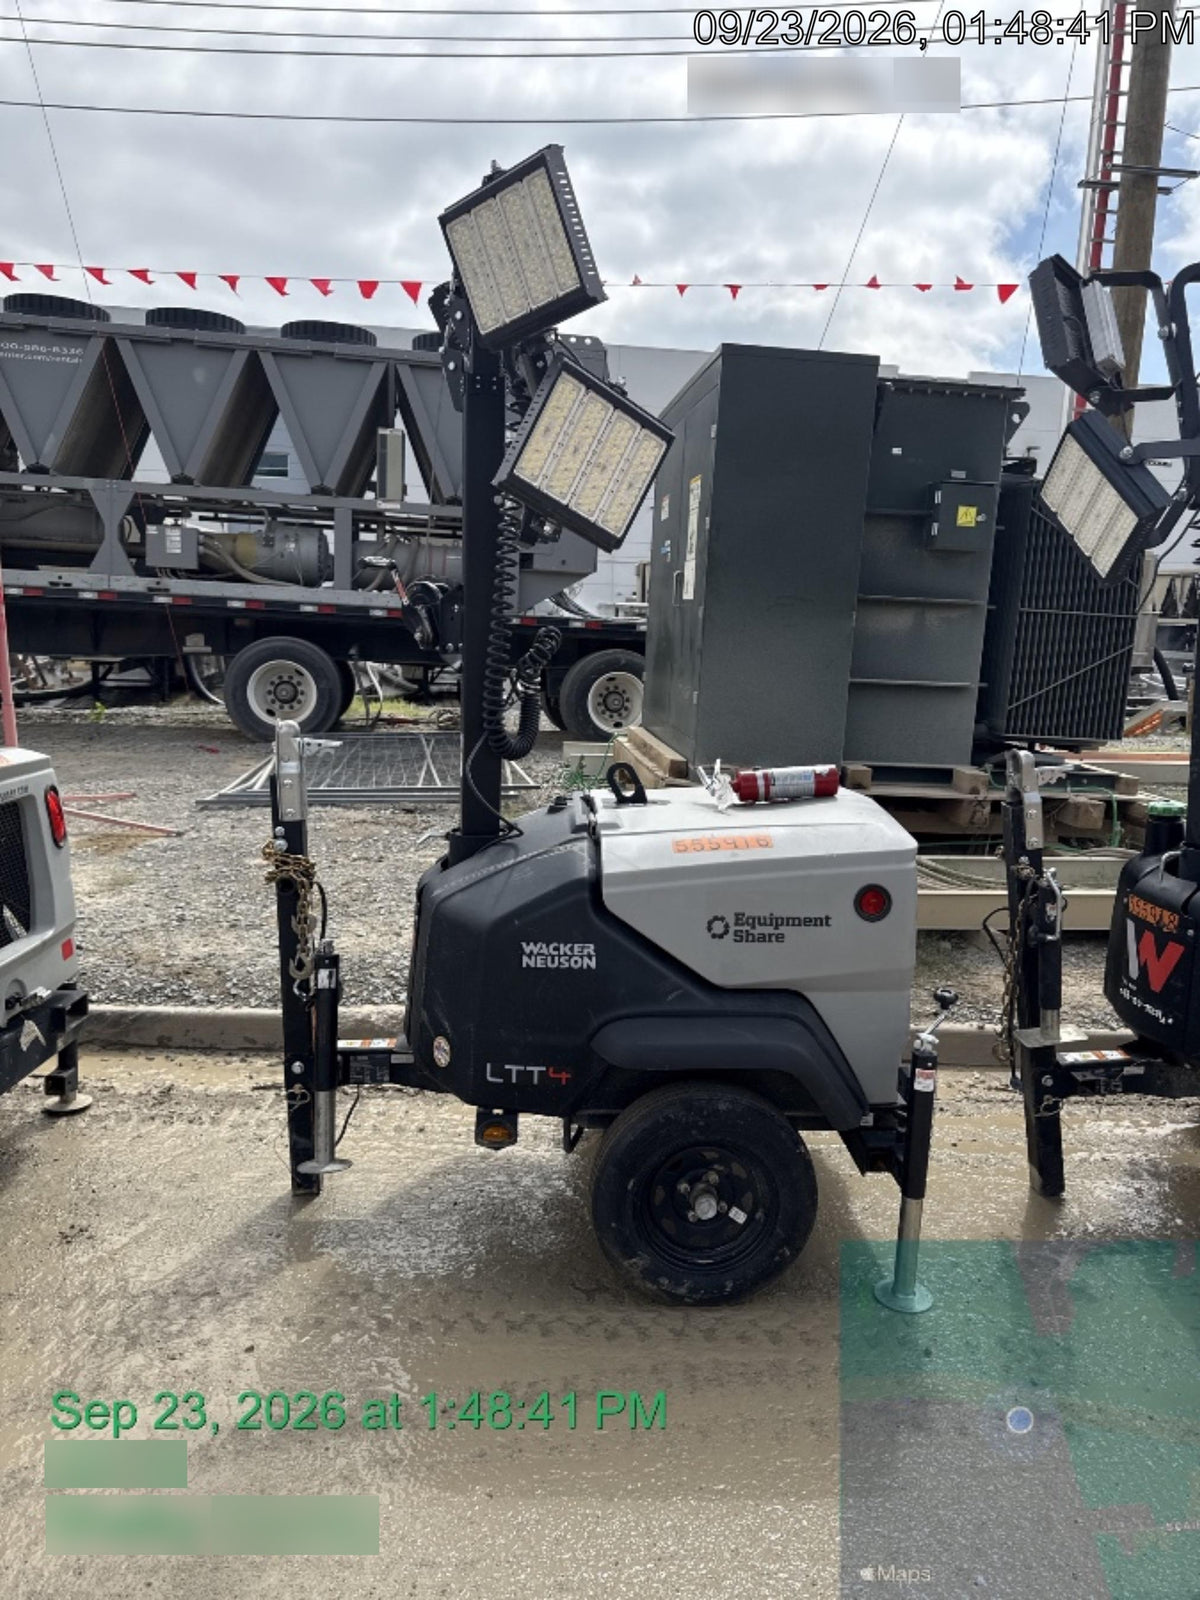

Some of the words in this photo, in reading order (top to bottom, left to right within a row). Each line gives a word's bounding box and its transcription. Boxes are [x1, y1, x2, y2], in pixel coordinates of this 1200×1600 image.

[733, 911, 832, 930] Equipment
[733, 929, 785, 943] Share
[520, 941, 596, 956] WACKER
[521, 955, 597, 970] NEUSON
[486, 1062, 571, 1086] LTT4
